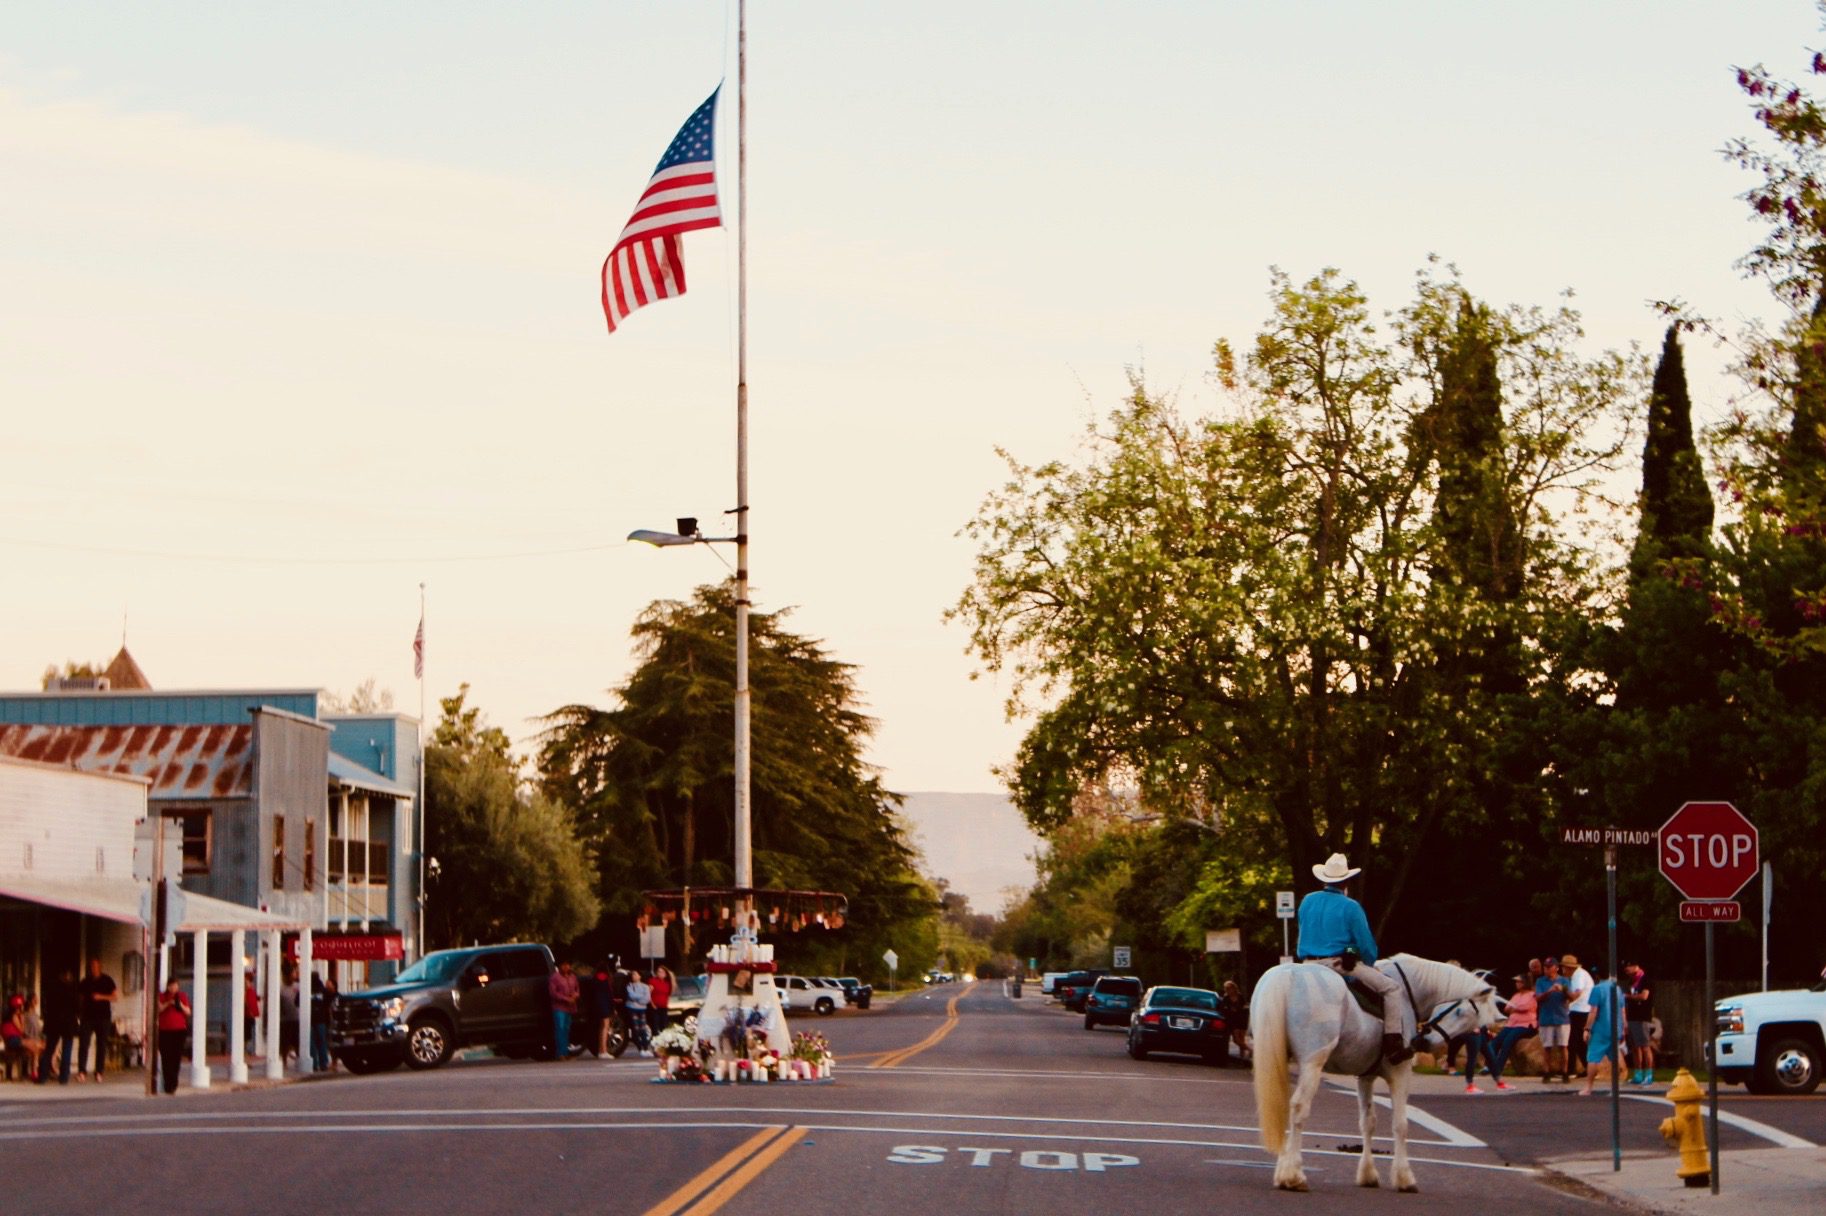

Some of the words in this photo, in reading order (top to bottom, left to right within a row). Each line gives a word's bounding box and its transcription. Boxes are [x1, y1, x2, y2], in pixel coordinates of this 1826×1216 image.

[1564, 829, 1600, 843] ALAMO
[1604, 830, 1650, 845] PINTADO
[1665, 834, 1752, 868] STOP
[1685, 906, 1704, 917] ALL
[1713, 906, 1734, 917] WAY
[886, 1145, 1141, 1171] STOP
